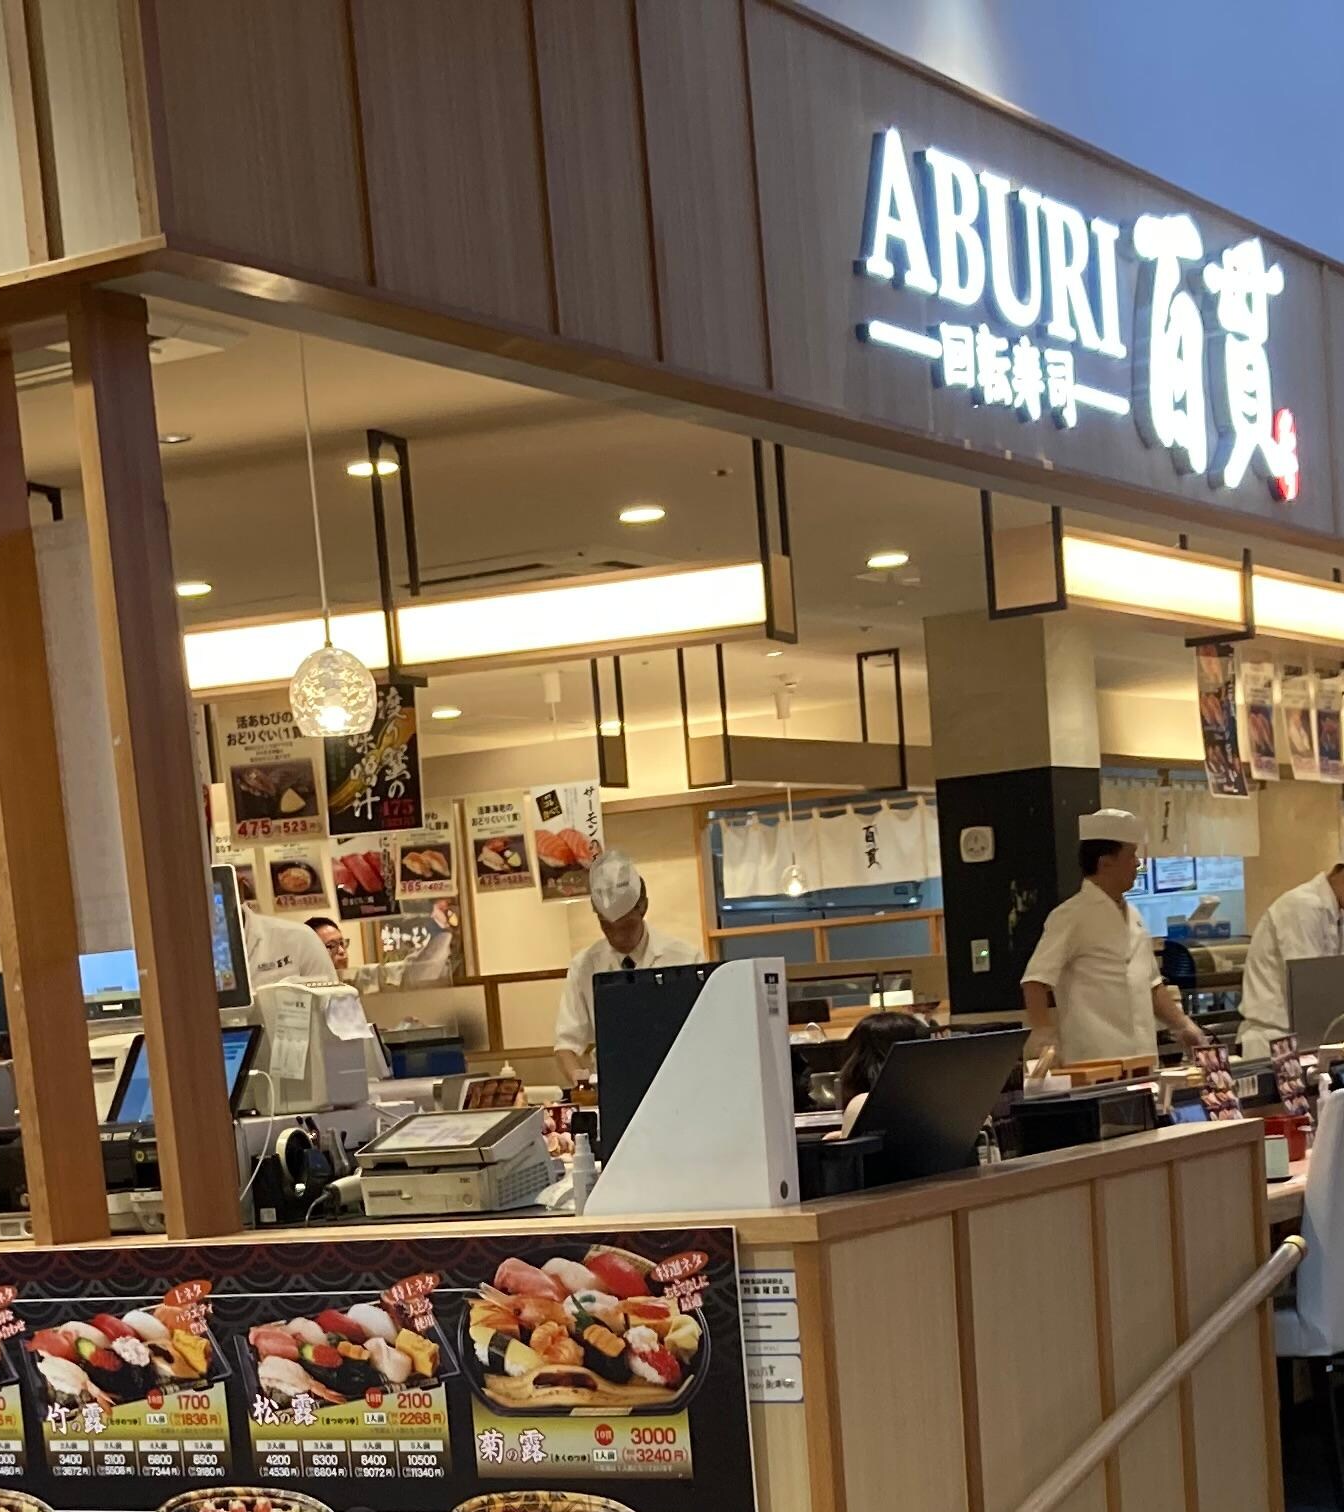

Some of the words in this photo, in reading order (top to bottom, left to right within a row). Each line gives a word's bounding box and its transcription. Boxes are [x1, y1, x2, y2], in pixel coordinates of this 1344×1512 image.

[865, 127, 1127, 359] ABURI
[1133, 213, 1288, 490] 百貫
[941, 322, 1077, 428] 回転寿司
[238, 820, 271, 836] 475
[177, 1395, 210, 1410] 1700
[253, 1393, 317, 1426] 松の露
[366, 1414, 385, 1424] 1人前
[397, 1393, 433, 1408] 2100
[47, 1402, 106, 1435] 竹の露
[477, 1428, 547, 1464] 菊の露
[595, 1451, 616, 1461] 1人前
[631, 1427, 677, 1445] 3000
[265, 1454, 290, 1465] 4200
[407, 1454, 436, 1465] 10500
